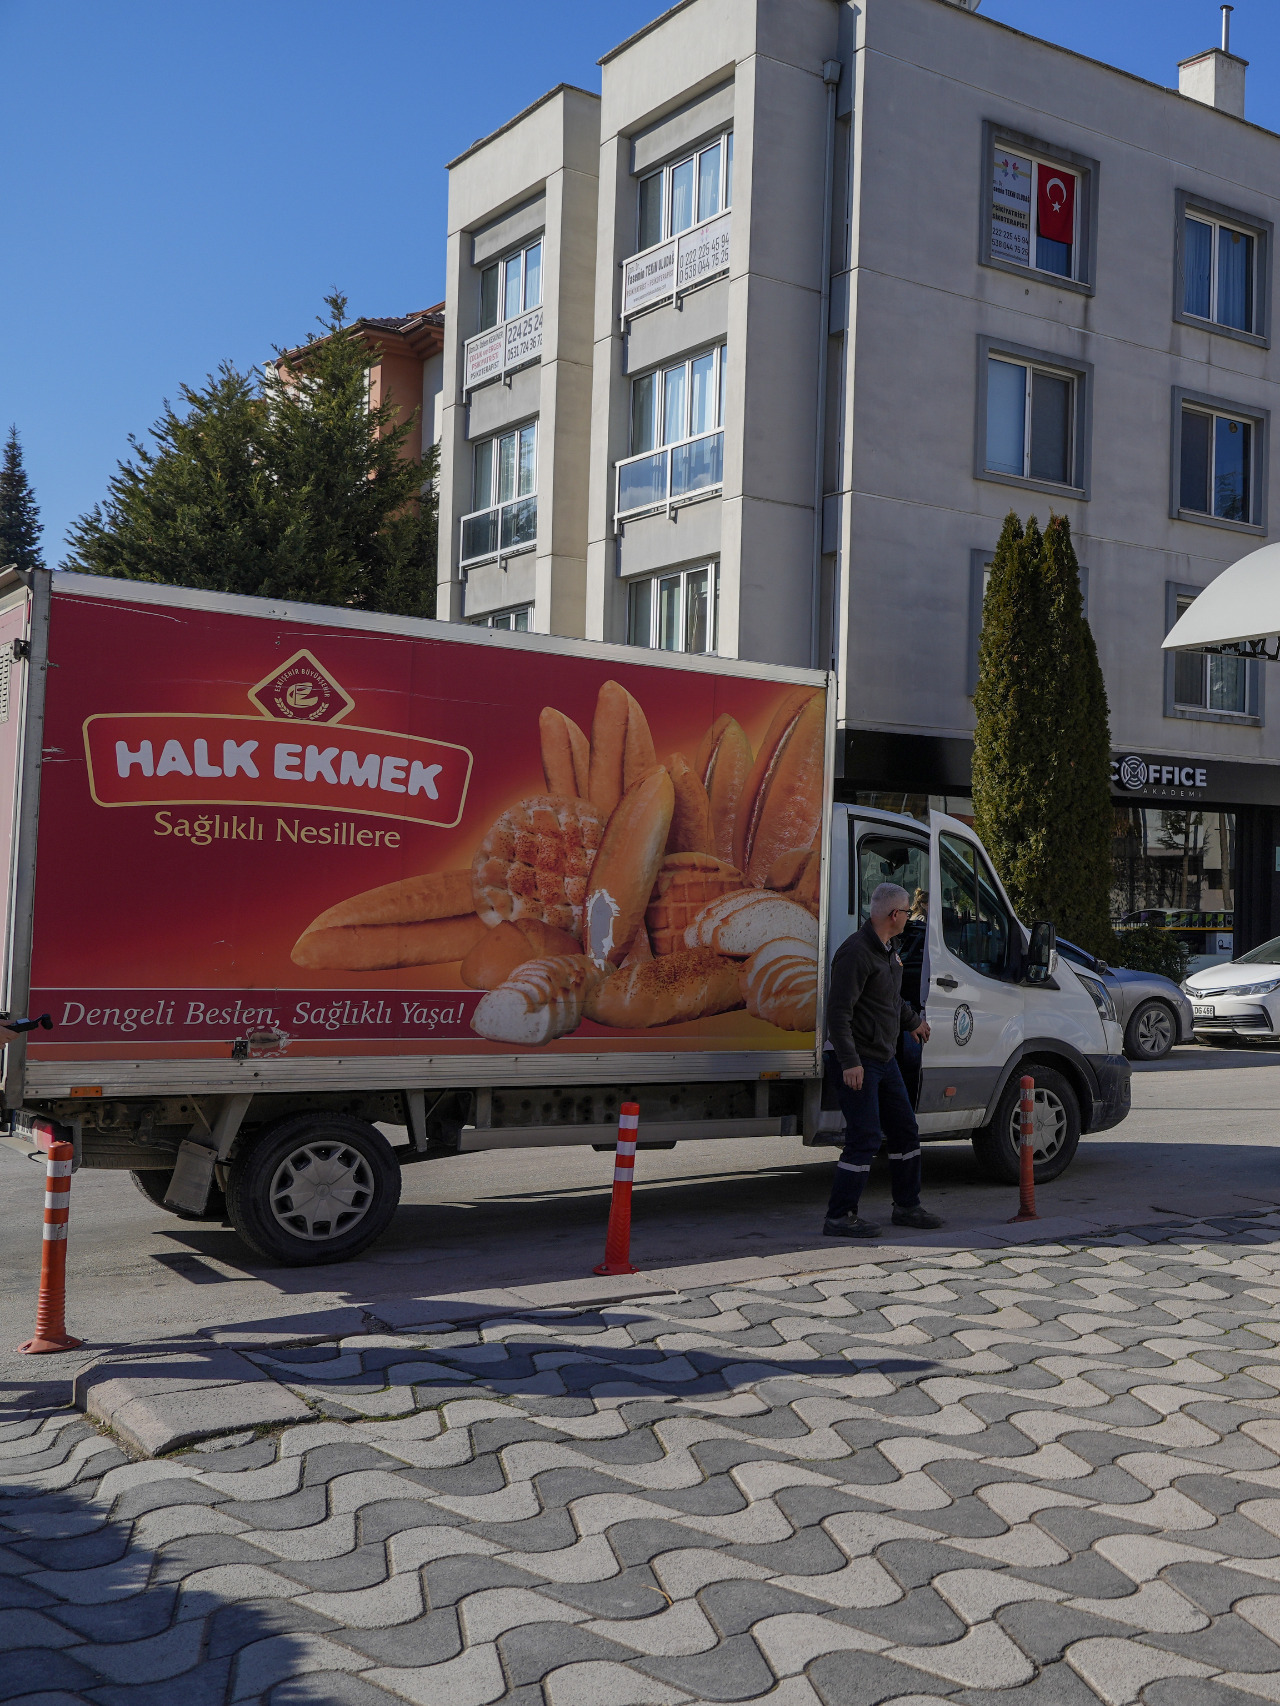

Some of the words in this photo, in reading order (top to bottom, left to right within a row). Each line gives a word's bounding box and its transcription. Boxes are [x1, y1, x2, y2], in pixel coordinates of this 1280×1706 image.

[992, 212, 1028, 230] SİKOTERAPİST
[684, 263, 697, 281] 538
[698, 258, 710, 274] 044
[711, 252, 720, 267] 75
[720, 248, 729, 264] 25
[686, 248, 697, 266] 222
[698, 242, 710, 260] 225
[711, 237, 720, 252] 45
[721, 232, 730, 248] 94
[508, 322, 522, 345] 224
[523, 317, 533, 338] 25
[534, 311, 543, 331] 24
[115, 738, 260, 779] HALK
[273, 742, 443, 800] EKMEK
[153, 810, 264, 846] Sağlıklı
[275, 818, 401, 849] Nesillere
[59, 1000, 176, 1033] Dengeli
[183, 1000, 281, 1029] Beslen,
[292, 1000, 393, 1031] Sağlıklı
[401, 1001, 464, 1031] Yaşa!
